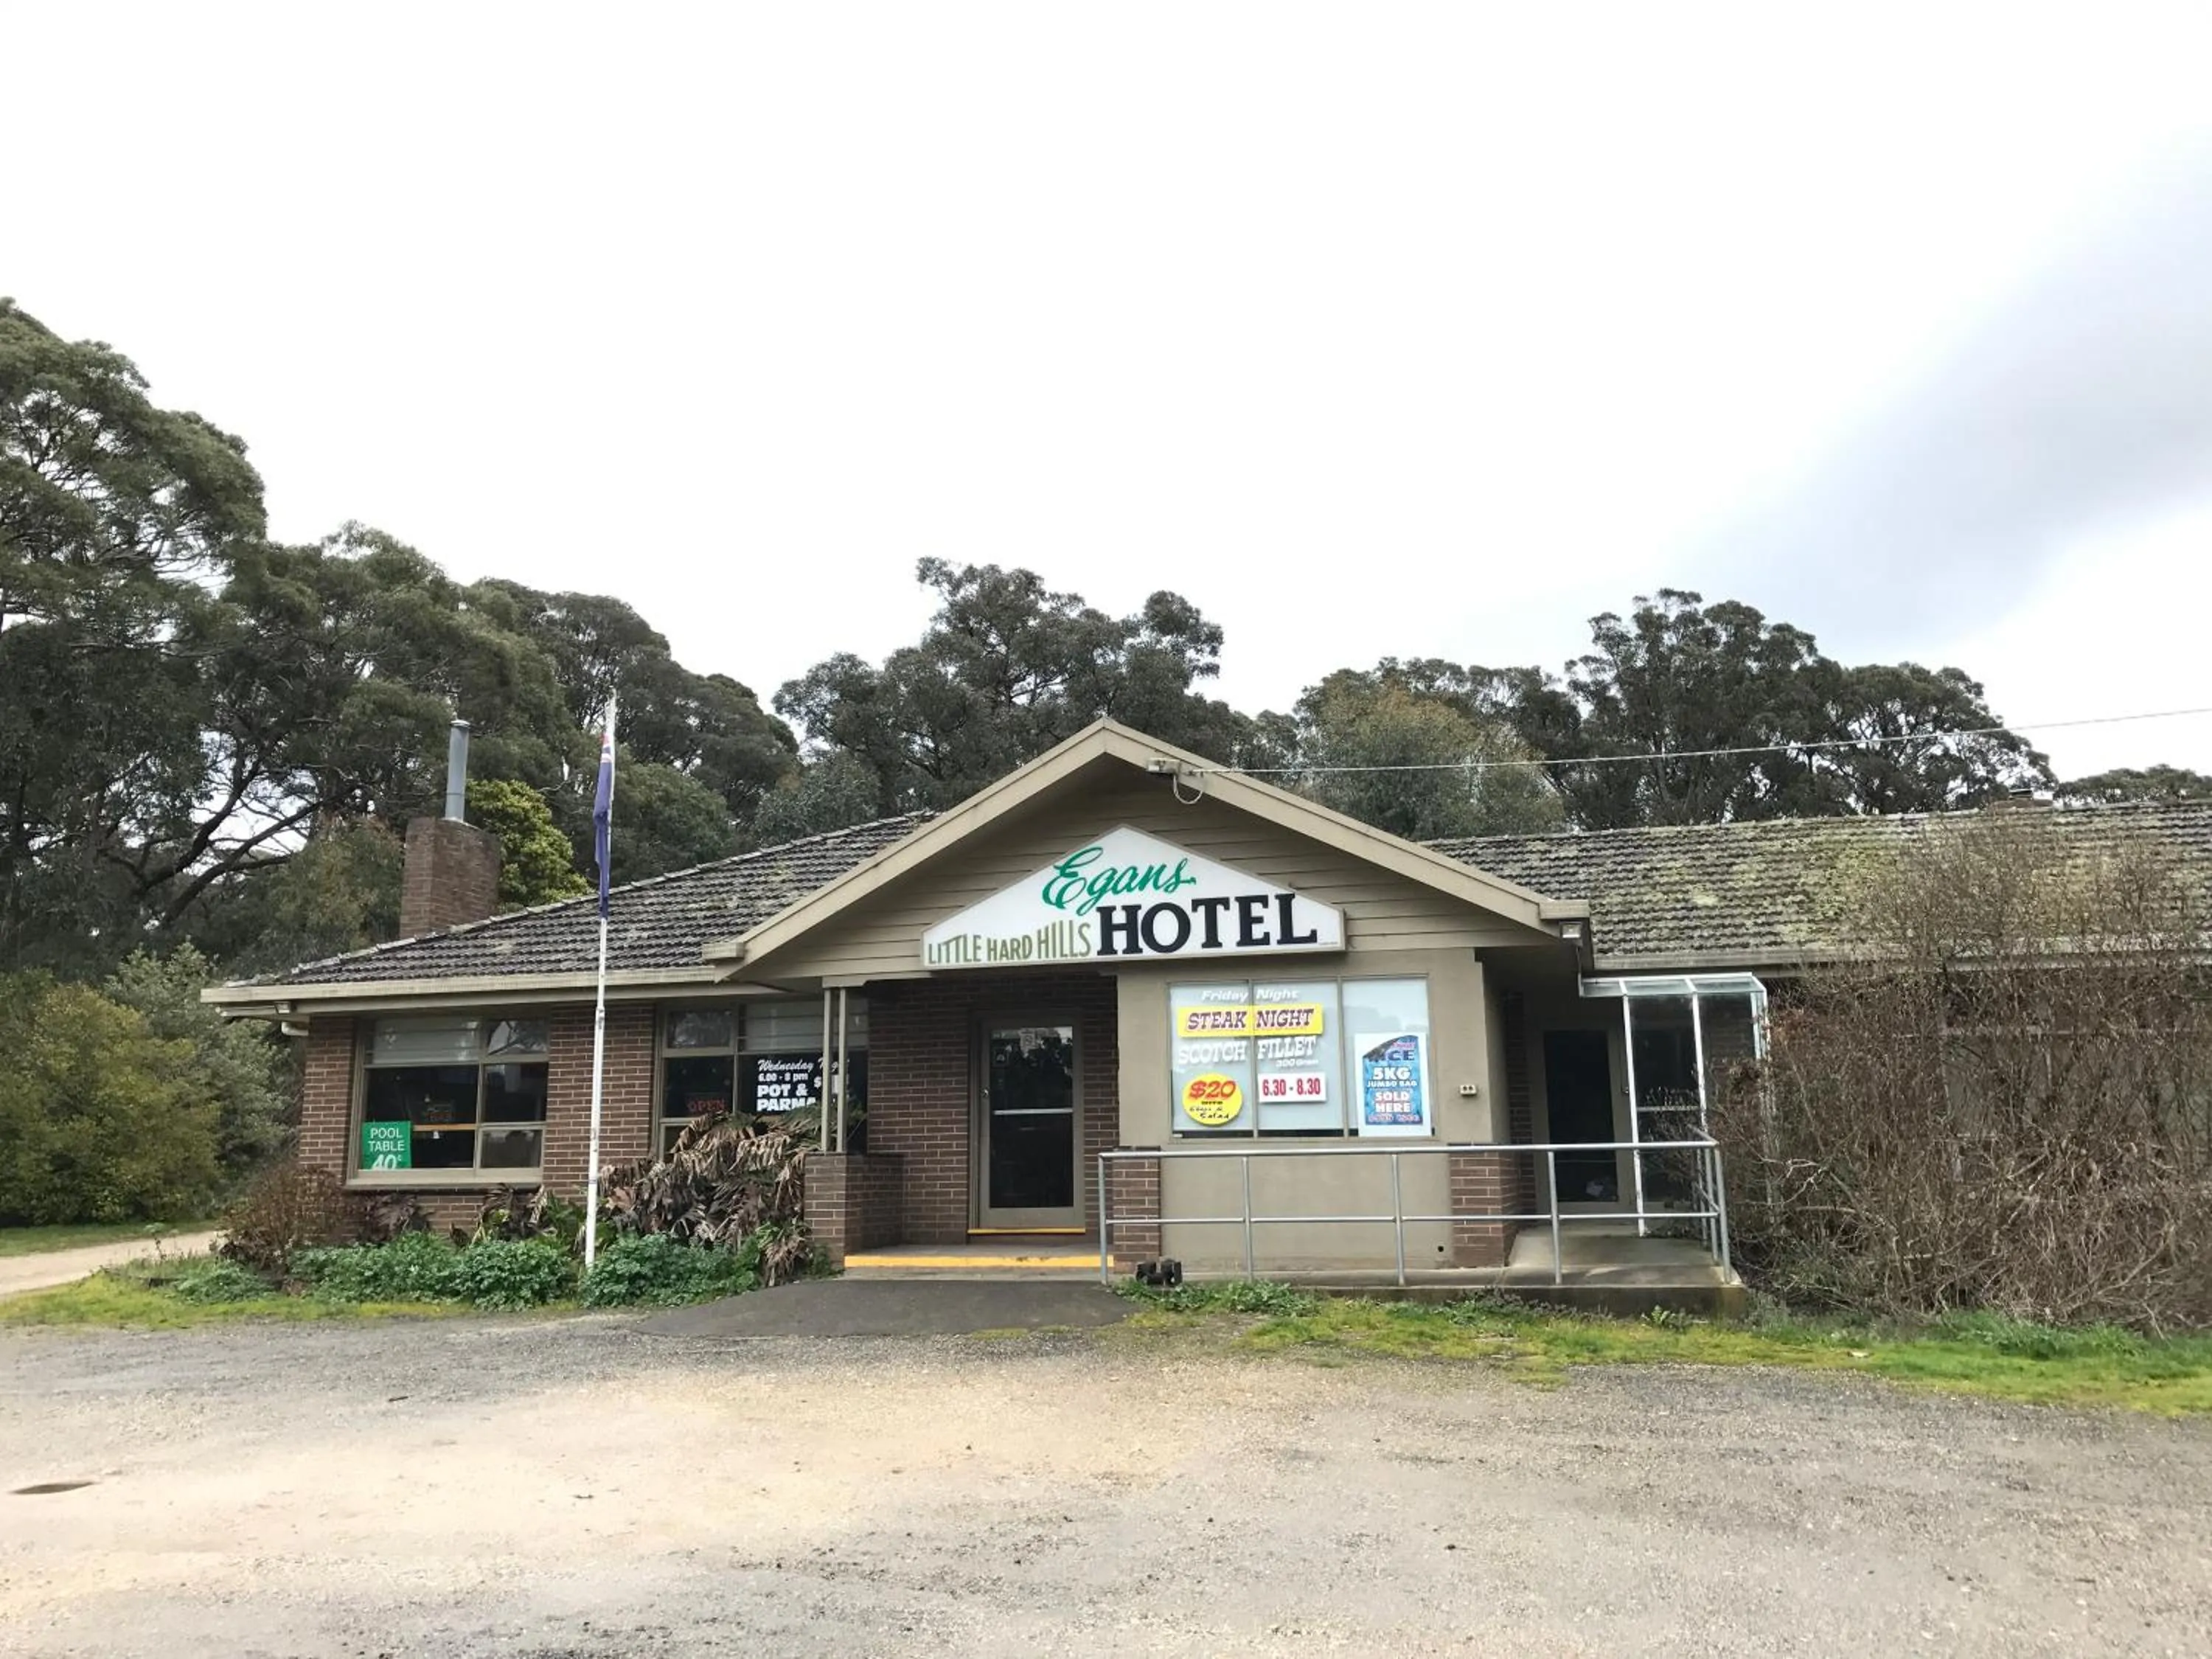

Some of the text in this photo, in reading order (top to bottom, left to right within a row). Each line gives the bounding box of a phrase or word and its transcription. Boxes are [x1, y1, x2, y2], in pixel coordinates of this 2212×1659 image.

[1043, 847, 1196, 916] Egans
[1096, 893, 1317, 956] HOTEL
[928, 920, 1091, 964] LITTLE HARD HILLS
[1201, 990, 1299, 1002] Friday Night
[1188, 1009, 1314, 1029] STEAK NIGHT
[1178, 1036, 1316, 1065] SCOTCH FILLET
[757, 1059, 814, 1073] Wednesday
[793, 1074, 808, 1082] pm
[1373, 1067, 1411, 1080] 5KG
[757, 1084, 791, 1097] POT
[796, 1083, 808, 1096] &
[1189, 1081, 1236, 1099] $20
[1262, 1079, 1287, 1096] 6.30
[1297, 1078, 1321, 1095] 8.30
[1375, 1091, 1410, 1101] SOLD
[1375, 1103, 1411, 1113] HERE
[371, 1127, 403, 1138] POOL
[367, 1140, 405, 1152] TABLE
